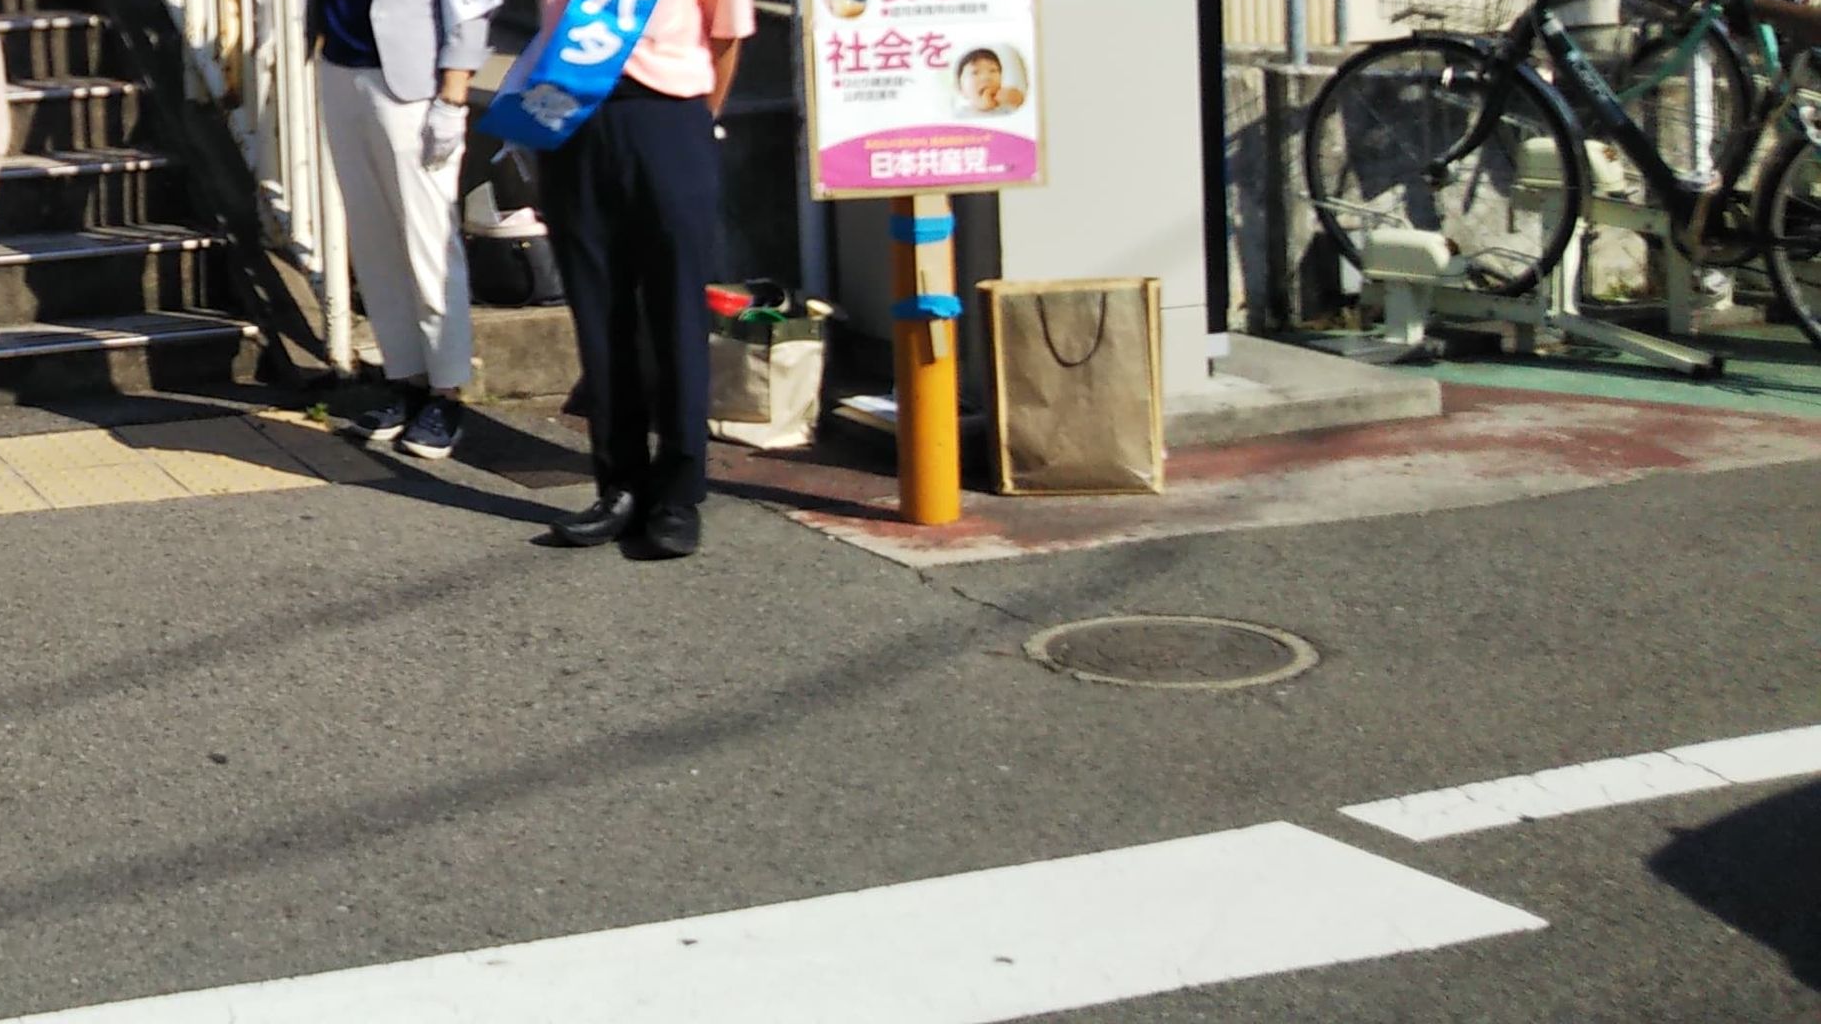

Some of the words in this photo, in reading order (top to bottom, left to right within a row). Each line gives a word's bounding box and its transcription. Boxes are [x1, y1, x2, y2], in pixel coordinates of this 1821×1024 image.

[826, 29, 952, 74] 社会を
[870, 147, 989, 178] 日本共産党
